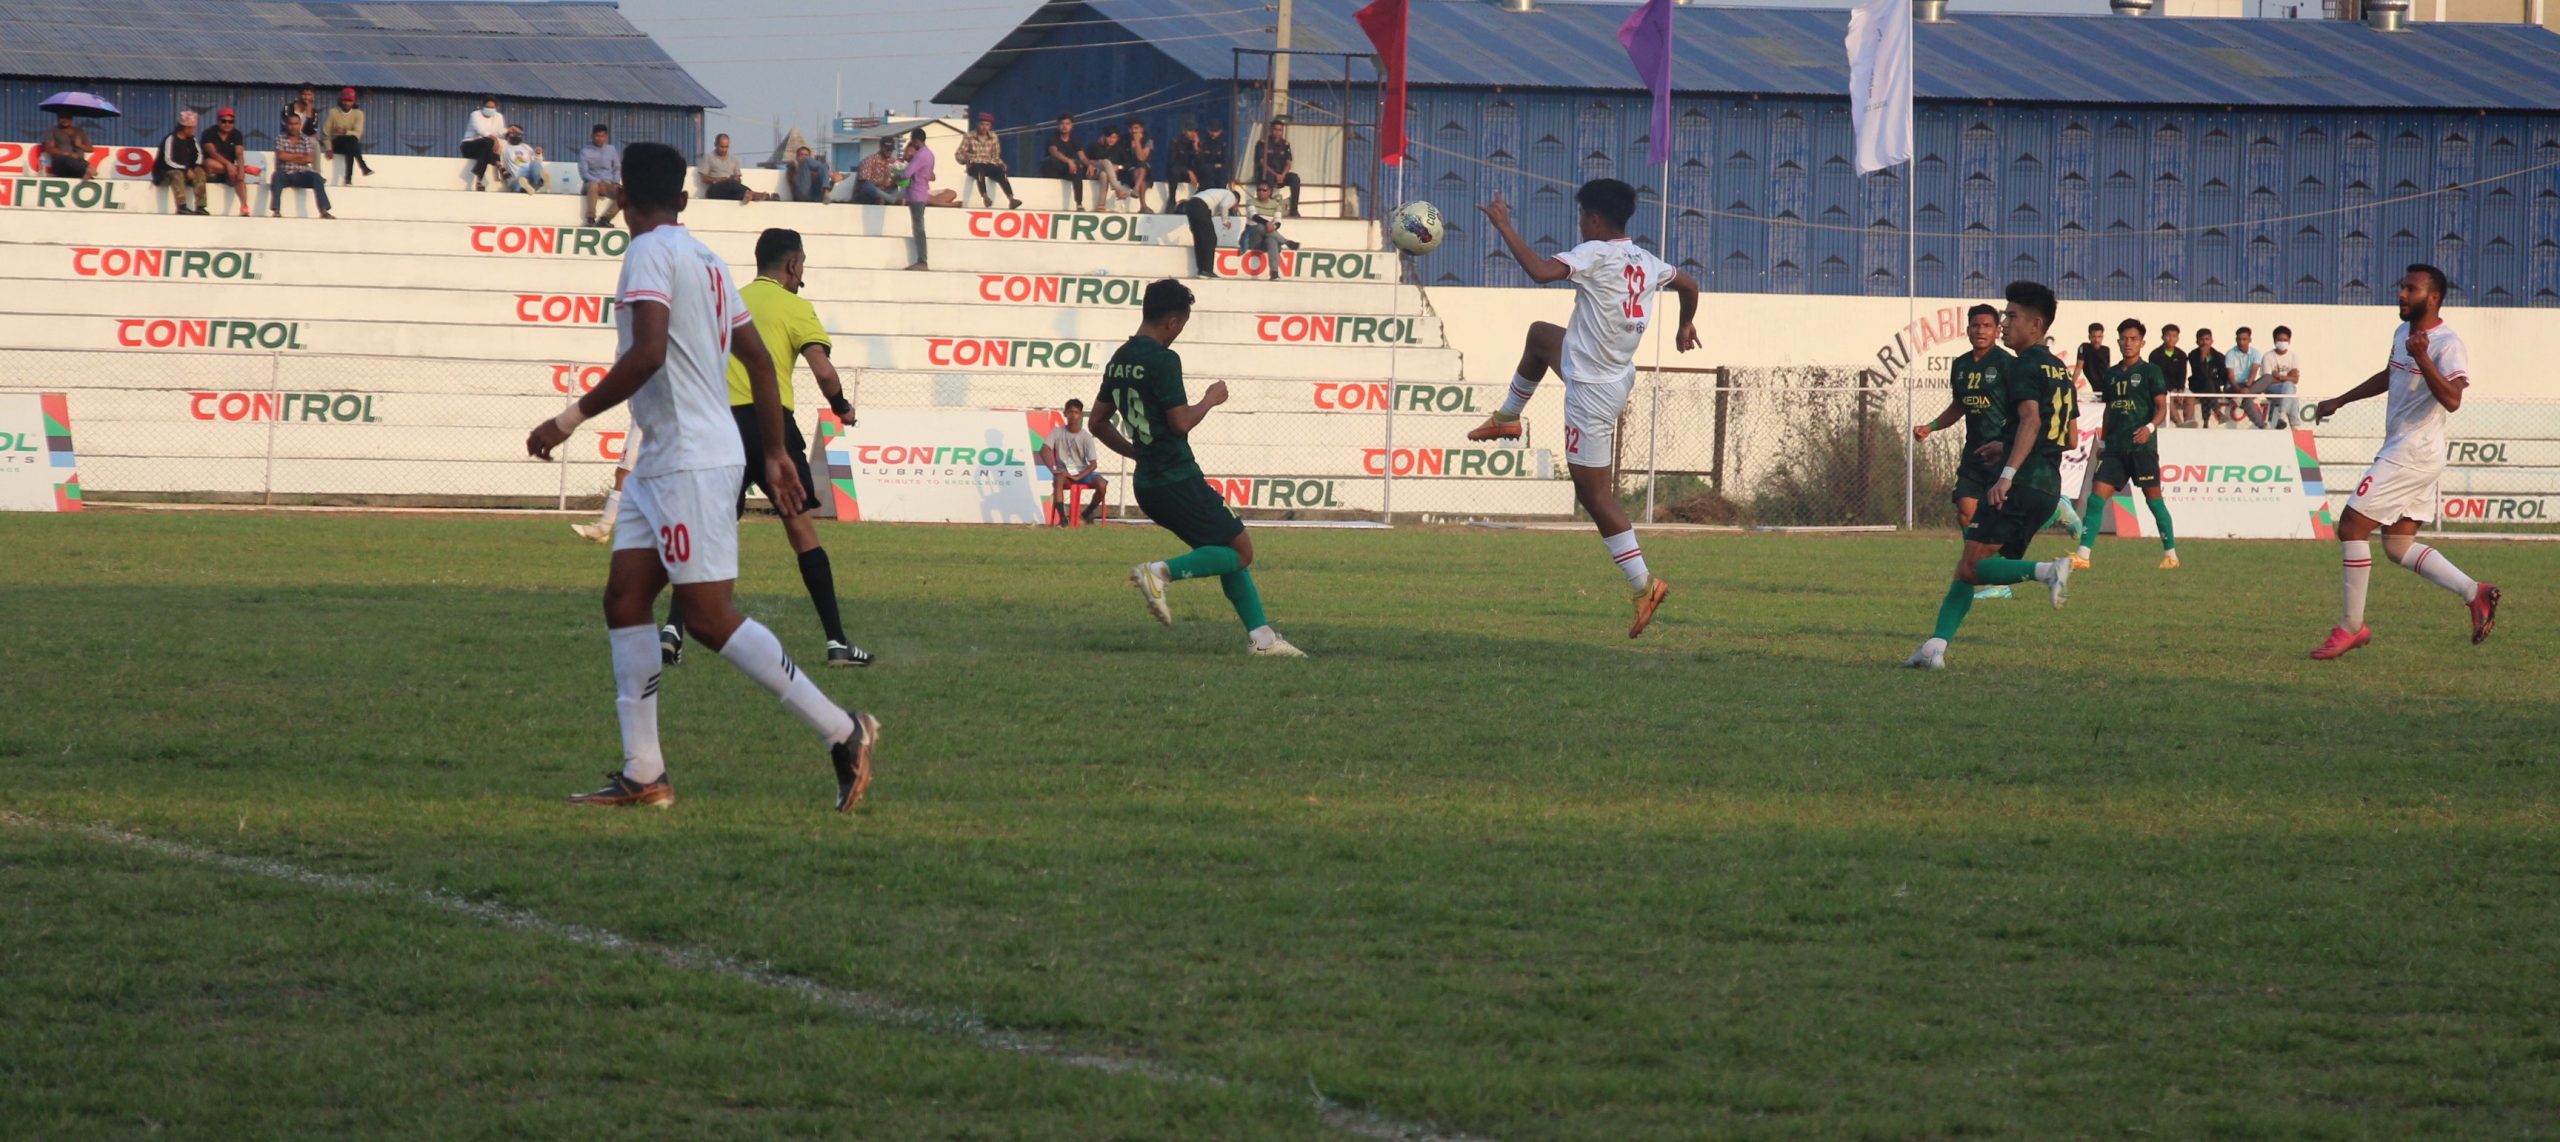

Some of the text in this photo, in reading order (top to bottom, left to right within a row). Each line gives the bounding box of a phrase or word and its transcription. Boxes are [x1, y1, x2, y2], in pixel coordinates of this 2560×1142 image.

[468, 225, 630, 256] CONTRO
[966, 211, 1142, 241] CONTROL
[69, 247, 256, 279] CONTROL
[977, 275, 1143, 306] CONTROL
[1623, 264, 1646, 318] 32
[513, 294, 616, 323] CONT
[116, 319, 301, 349] CONTROL
[1255, 314, 1417, 344] CONTROL
[925, 338, 1094, 369] CONTROL
[1928, 356, 1957, 371] EST
[1108, 363, 1145, 380] TAFC
[1903, 376, 1952, 389] TRAININ
[1968, 372, 1982, 389] 22
[1313, 382, 1476, 413] CONTROL
[2116, 380, 2128, 396] 17
[186, 392, 375, 422] CONTROL
[2048, 387, 2074, 447] 11
[853, 445, 1025, 466] CONTROL
[1360, 448, 1526, 477] CONTROL
[2446, 441, 2508, 463] TROL
[862, 468, 1023, 478] LUBRICANTS
[2160, 464, 2294, 483] ONTROL
[2356, 476, 2373, 496] 6
[1205, 479, 1338, 507] NTROL
[2160, 486, 2292, 494] BRICANTS
[2442, 498, 2547, 519] ONTROL
[661, 523, 690, 563] 20
